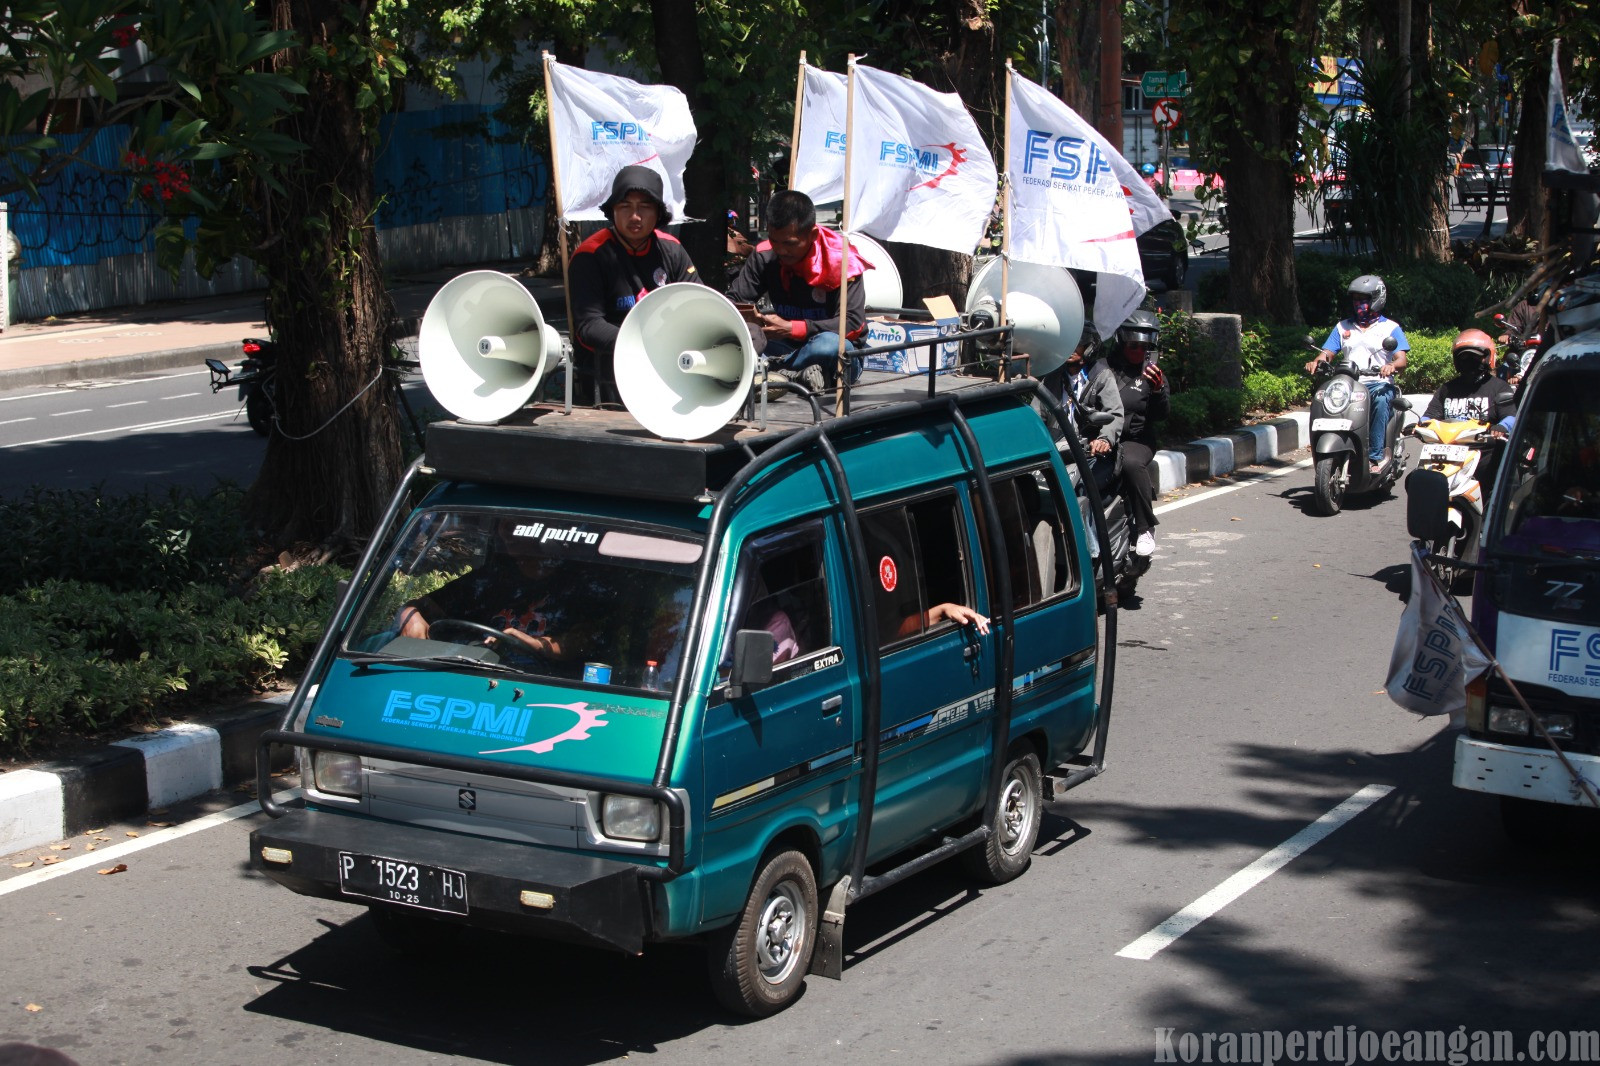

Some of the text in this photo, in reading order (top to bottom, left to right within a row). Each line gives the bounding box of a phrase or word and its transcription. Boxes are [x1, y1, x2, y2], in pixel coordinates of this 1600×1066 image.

[1022, 176, 1052, 188] FEDERASI
[1053, 182, 1082, 193] SERIKAT
[867, 328, 902, 343] Ampo
[513, 522, 599, 544] adi putro
[1544, 580, 1583, 598] 77
[813, 653, 840, 671] EXTRA
[1548, 673, 1588, 687] FEDERASI
[382, 689, 534, 738] FSPMI
[381, 717, 525, 744] FEDERASI SERIKAT PEKERJA METAL INDONESIA
[342, 856, 464, 900] P 1523 HJ
